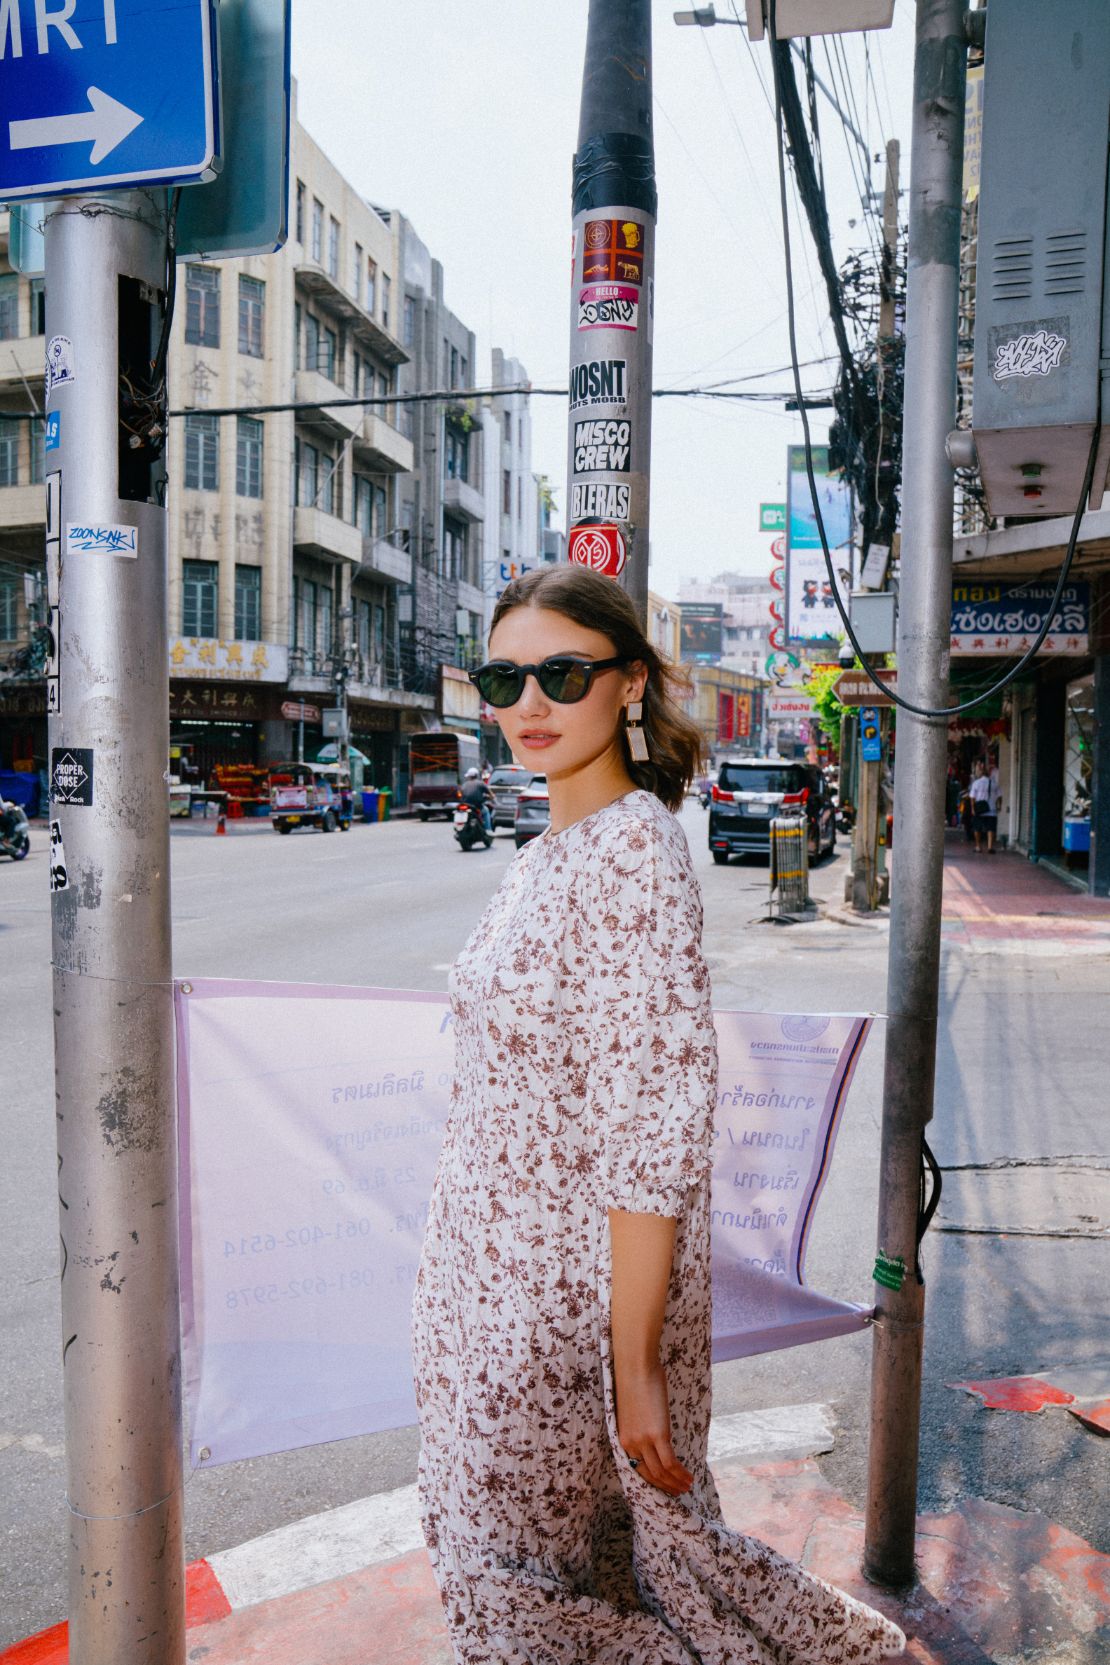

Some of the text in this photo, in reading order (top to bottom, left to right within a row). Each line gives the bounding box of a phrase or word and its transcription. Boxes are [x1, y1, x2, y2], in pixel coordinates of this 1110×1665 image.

[595, 287, 619, 296] HELLO
[591, 396, 626, 405] MOBB
[575, 421, 630, 447] MISCO
[575, 445, 630, 472] CREW
[573, 485, 629, 518] BLERAS
[56, 764, 84, 776] PROPER
[58, 776, 79, 787] DOSE
